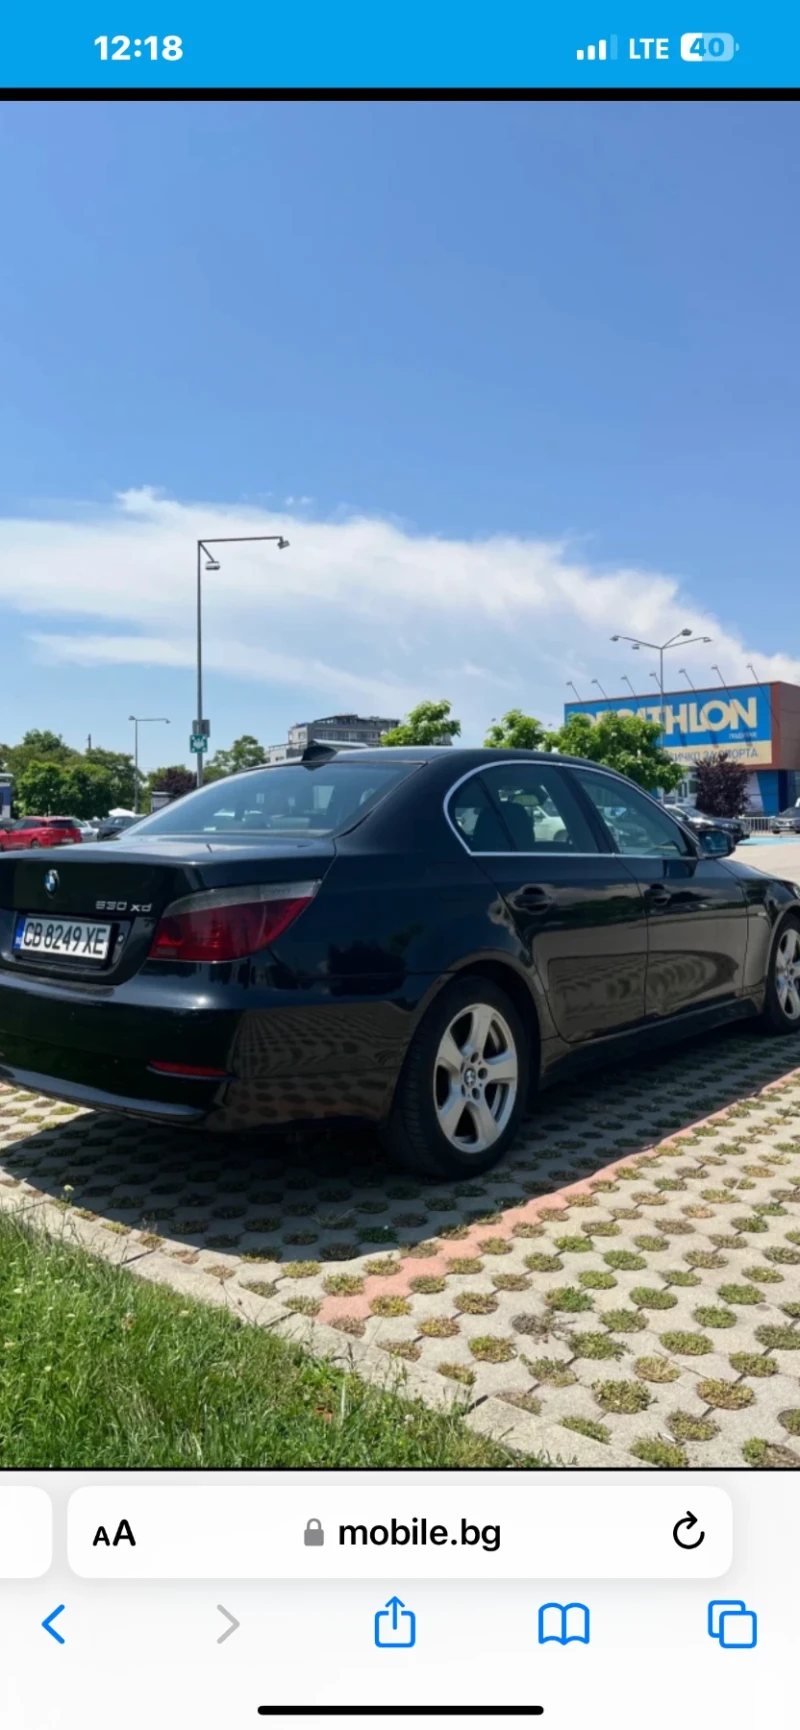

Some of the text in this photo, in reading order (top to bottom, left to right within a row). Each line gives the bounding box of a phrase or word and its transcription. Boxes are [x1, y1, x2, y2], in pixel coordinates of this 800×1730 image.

[582, 697, 757, 736] ATHLON
[23, 922, 107, 955] CB 8249 XE
